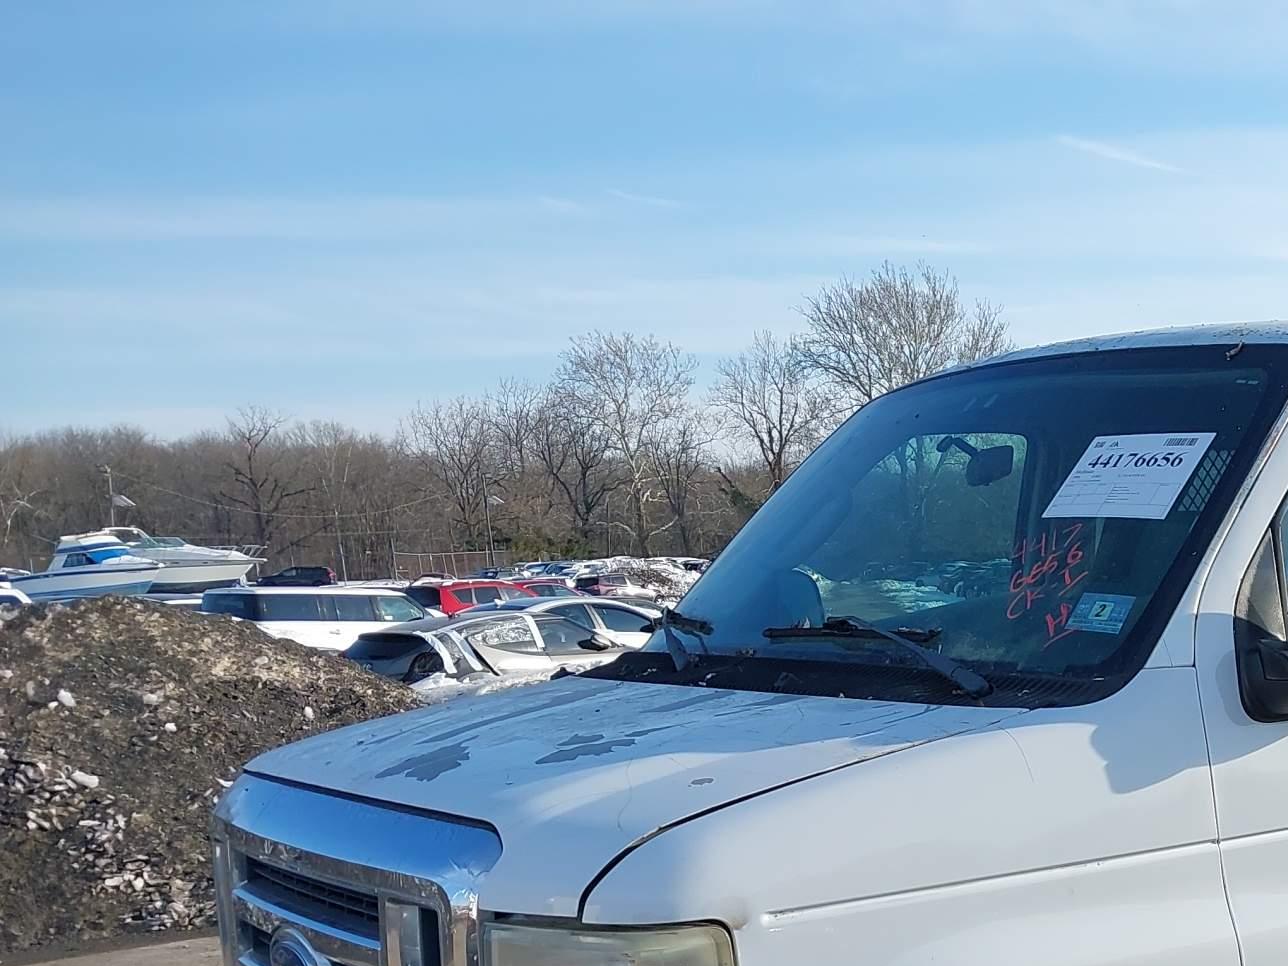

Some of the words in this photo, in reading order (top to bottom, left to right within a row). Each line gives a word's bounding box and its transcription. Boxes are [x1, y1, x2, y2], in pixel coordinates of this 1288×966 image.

[1087, 451, 1190, 469] 44176656
[1011, 523, 1083, 564] 4417
[1094, 604, 1107, 617] 2
